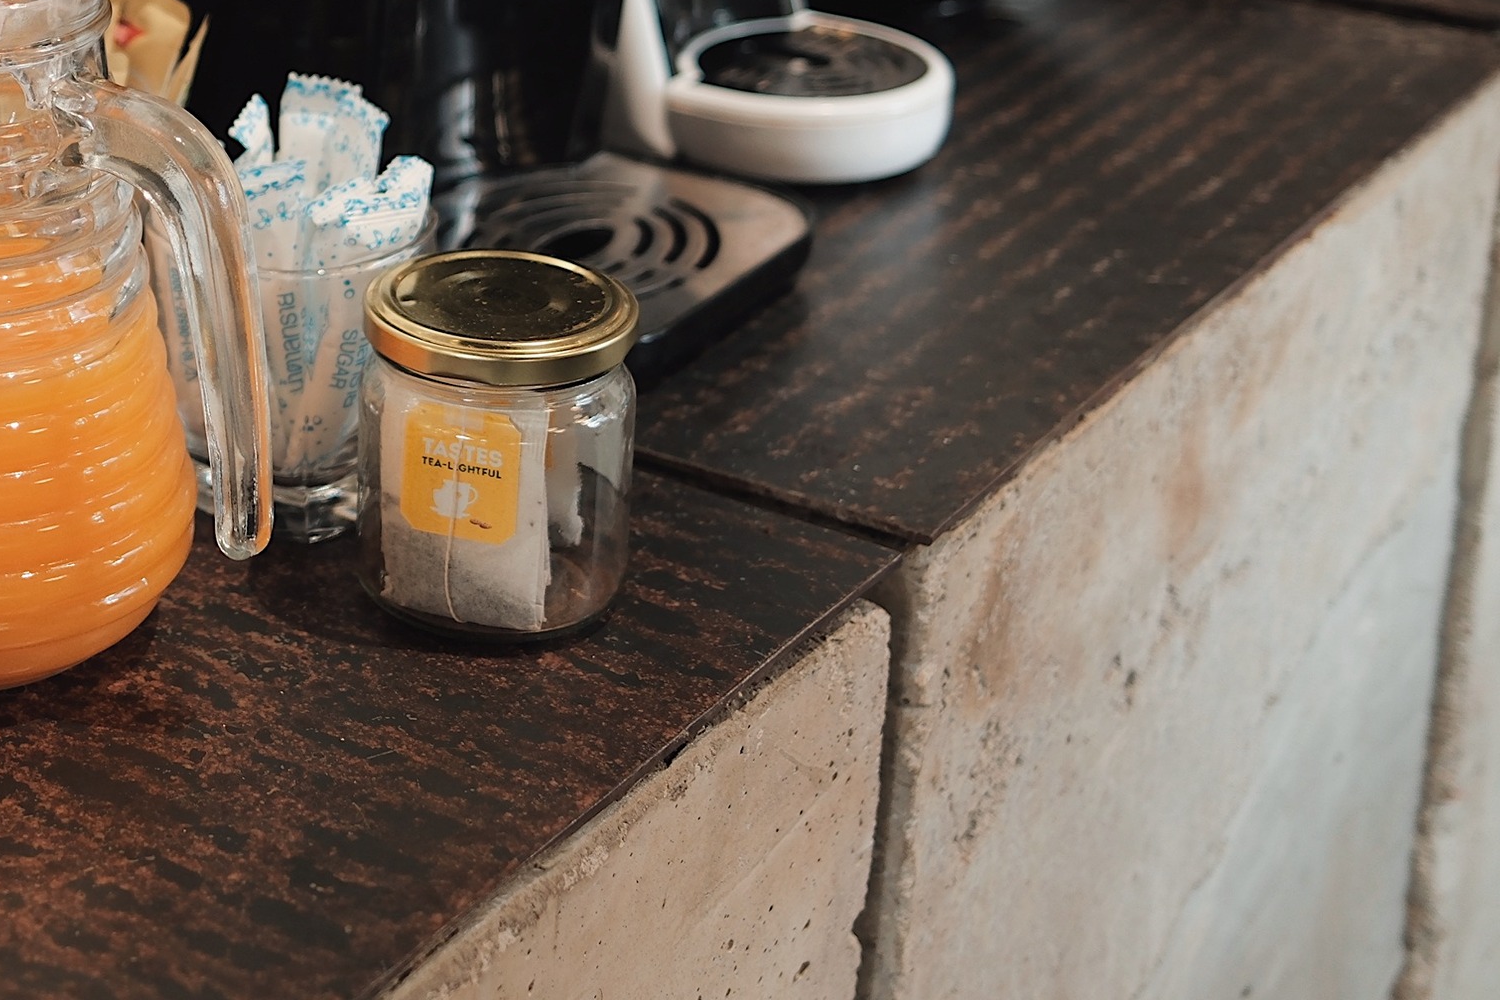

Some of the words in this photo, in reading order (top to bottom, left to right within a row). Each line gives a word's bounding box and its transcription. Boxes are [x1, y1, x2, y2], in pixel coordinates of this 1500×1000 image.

[329, 329, 359, 389] SUGAR
[422, 437, 503, 469] TASTES
[422, 455, 502, 480] TEA-LGHTFUL
